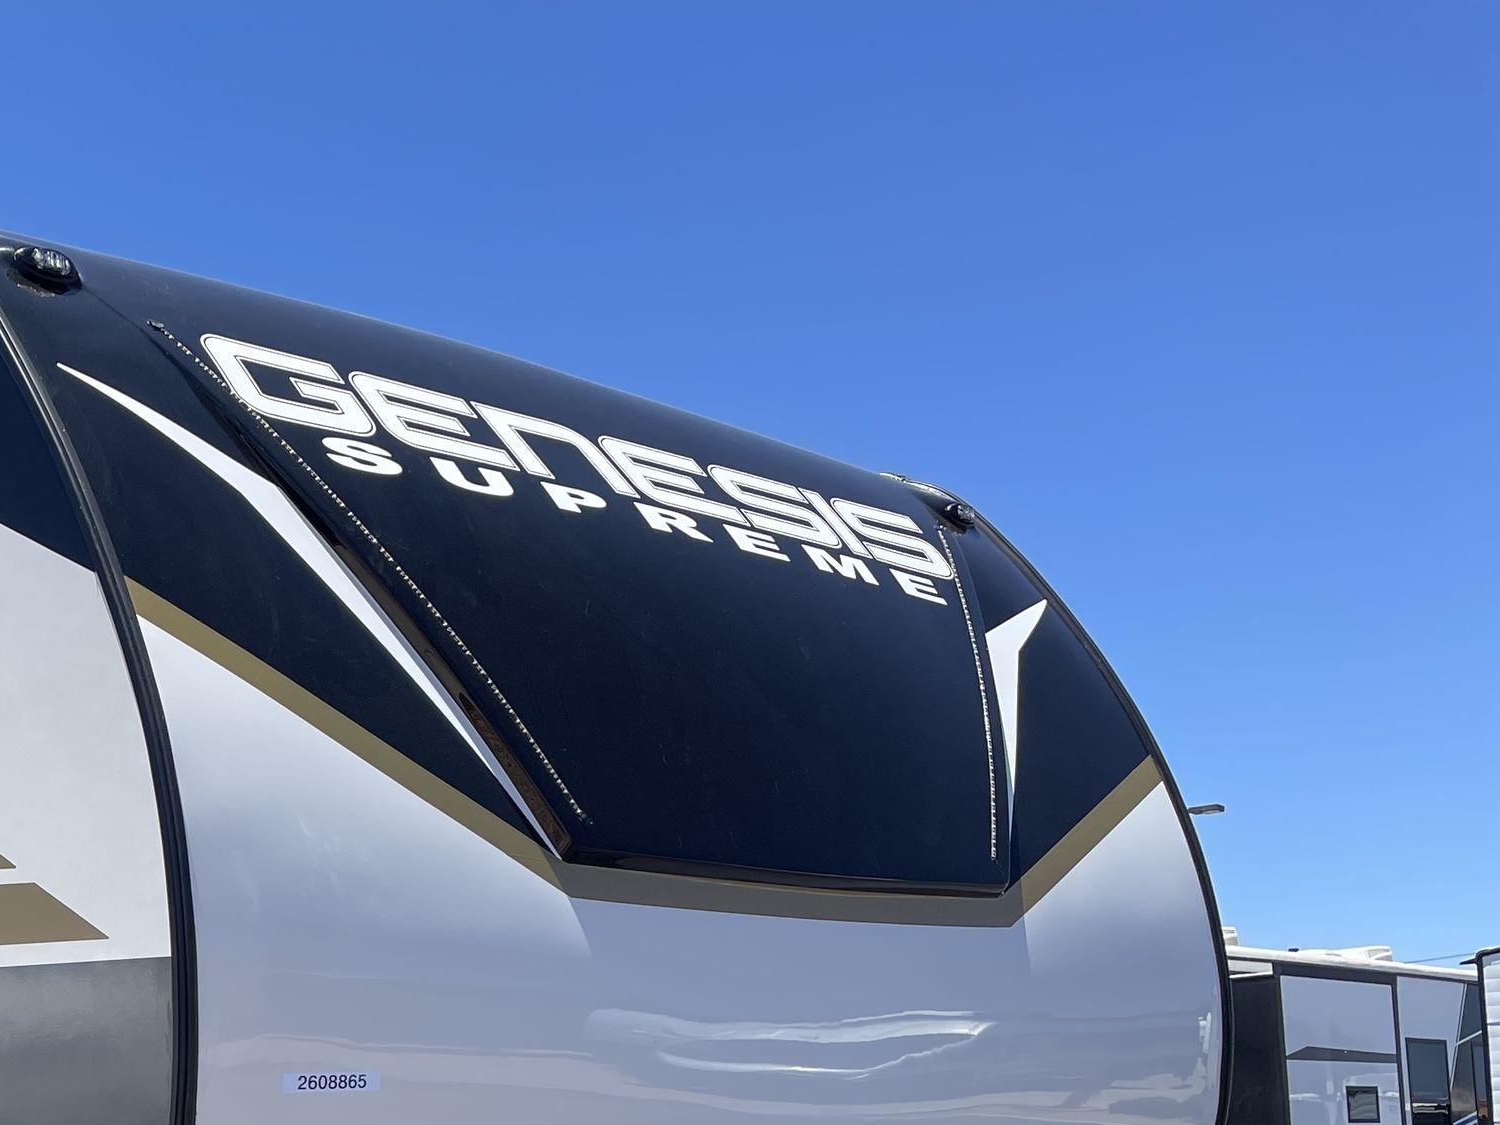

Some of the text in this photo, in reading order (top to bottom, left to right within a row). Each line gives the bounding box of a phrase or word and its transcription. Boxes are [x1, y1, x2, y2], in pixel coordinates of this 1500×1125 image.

[200, 333, 954, 581] GENESIS
[320, 437, 948, 606] SUPREME
[297, 1074, 367, 1090] 2608865
